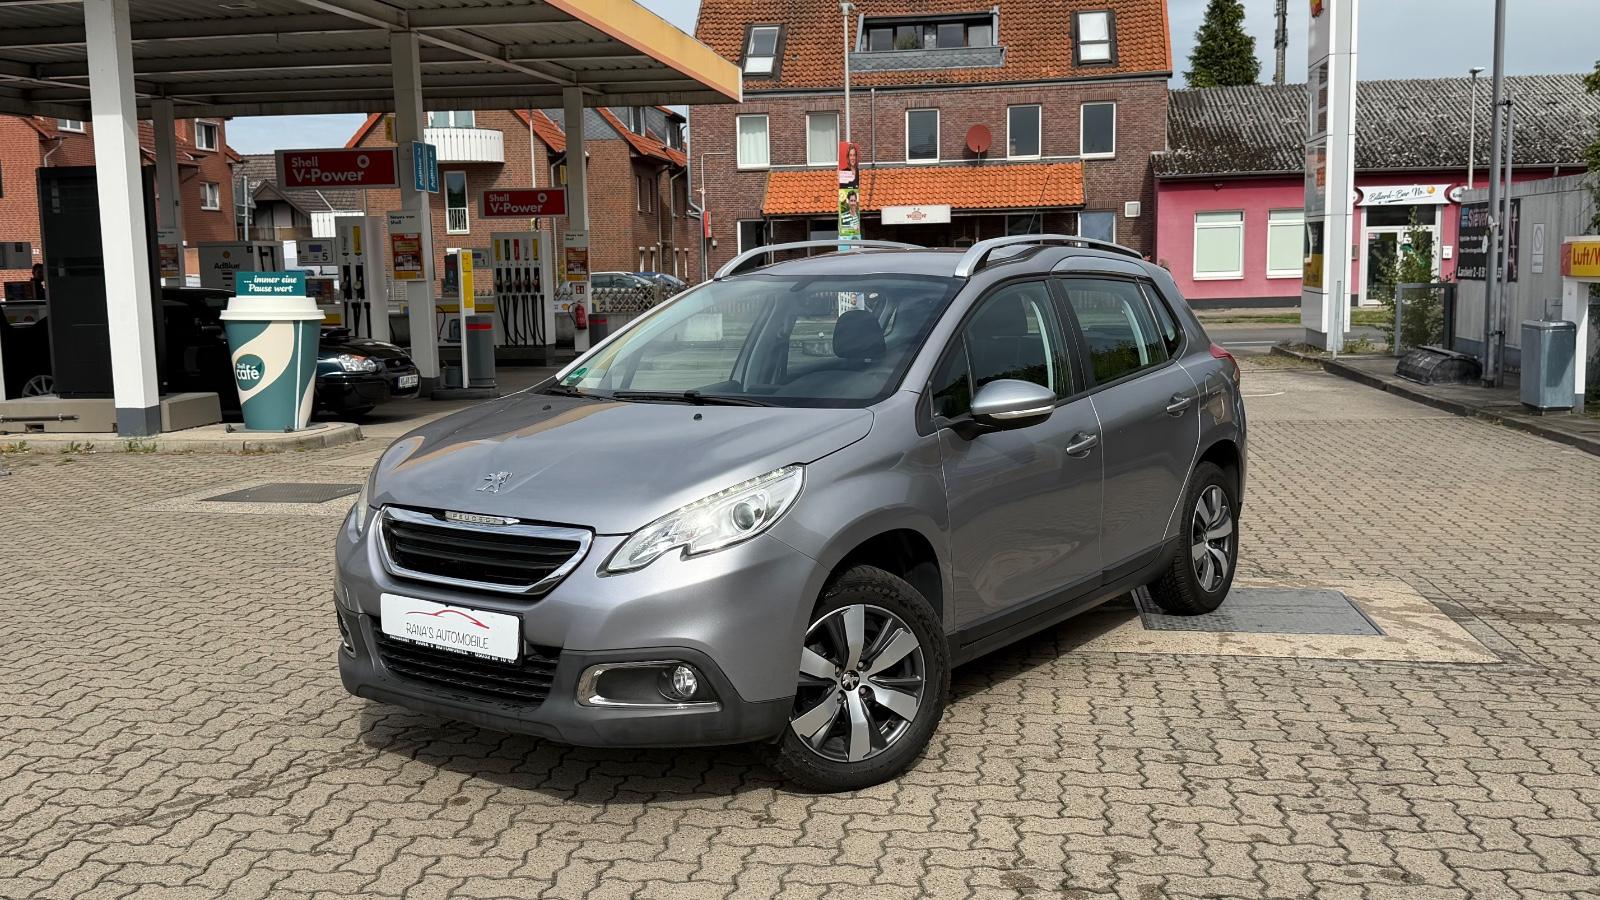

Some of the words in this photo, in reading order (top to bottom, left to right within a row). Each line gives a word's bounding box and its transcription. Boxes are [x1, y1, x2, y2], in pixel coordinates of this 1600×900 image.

[291, 155, 319, 168] Shell
[292, 168, 365, 183] V-Power
[488, 193, 510, 202] Shell
[490, 203, 543, 213] V-Power
[322, 252, 329, 261] 5
[253, 275, 280, 284] immer
[281, 275, 297, 284] eine
[248, 284, 272, 293] Pause
[273, 284, 294, 293] wert
[236, 365, 260, 381] café
[406, 622, 434, 639] RANA'S
[436, 628, 489, 649] AUTOMOBILE
